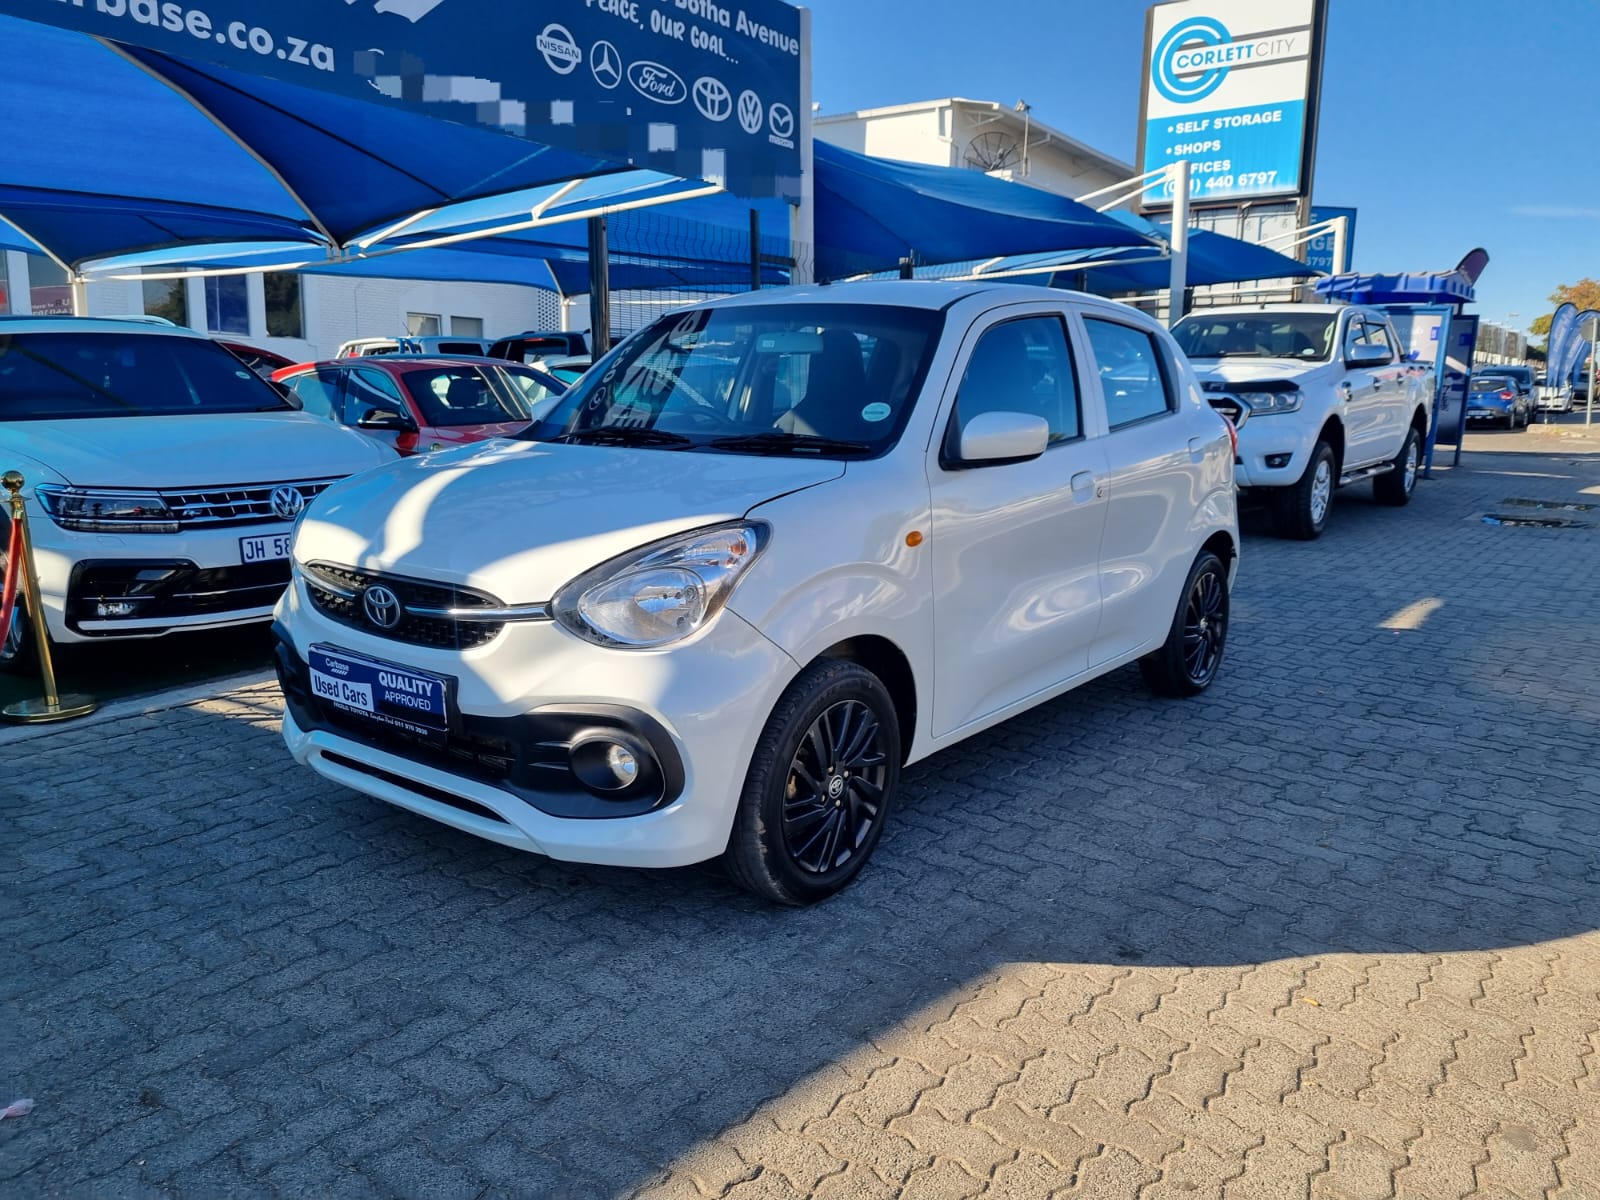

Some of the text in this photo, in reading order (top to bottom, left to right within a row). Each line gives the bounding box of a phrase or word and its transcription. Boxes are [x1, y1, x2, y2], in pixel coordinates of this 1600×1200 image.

[650, 9, 685, 41] OUR
[736, 10, 799, 56] Avenue
[539, 39, 580, 59] NISSAN
[639, 66, 677, 97] Ford
[1175, 110, 1282, 134] SELF STORAGE
[1174, 140, 1221, 156] SHOPS
[1190, 160, 1232, 174] FICES
[1205, 175, 1233, 189] 440
[1238, 170, 1277, 186] 6797
[246, 540, 266, 559] JH
[314, 675, 340, 697] Used
[343, 682, 368, 706] Cars
[378, 671, 433, 697] QUALITY
[384, 690, 431, 711] APPROVED
